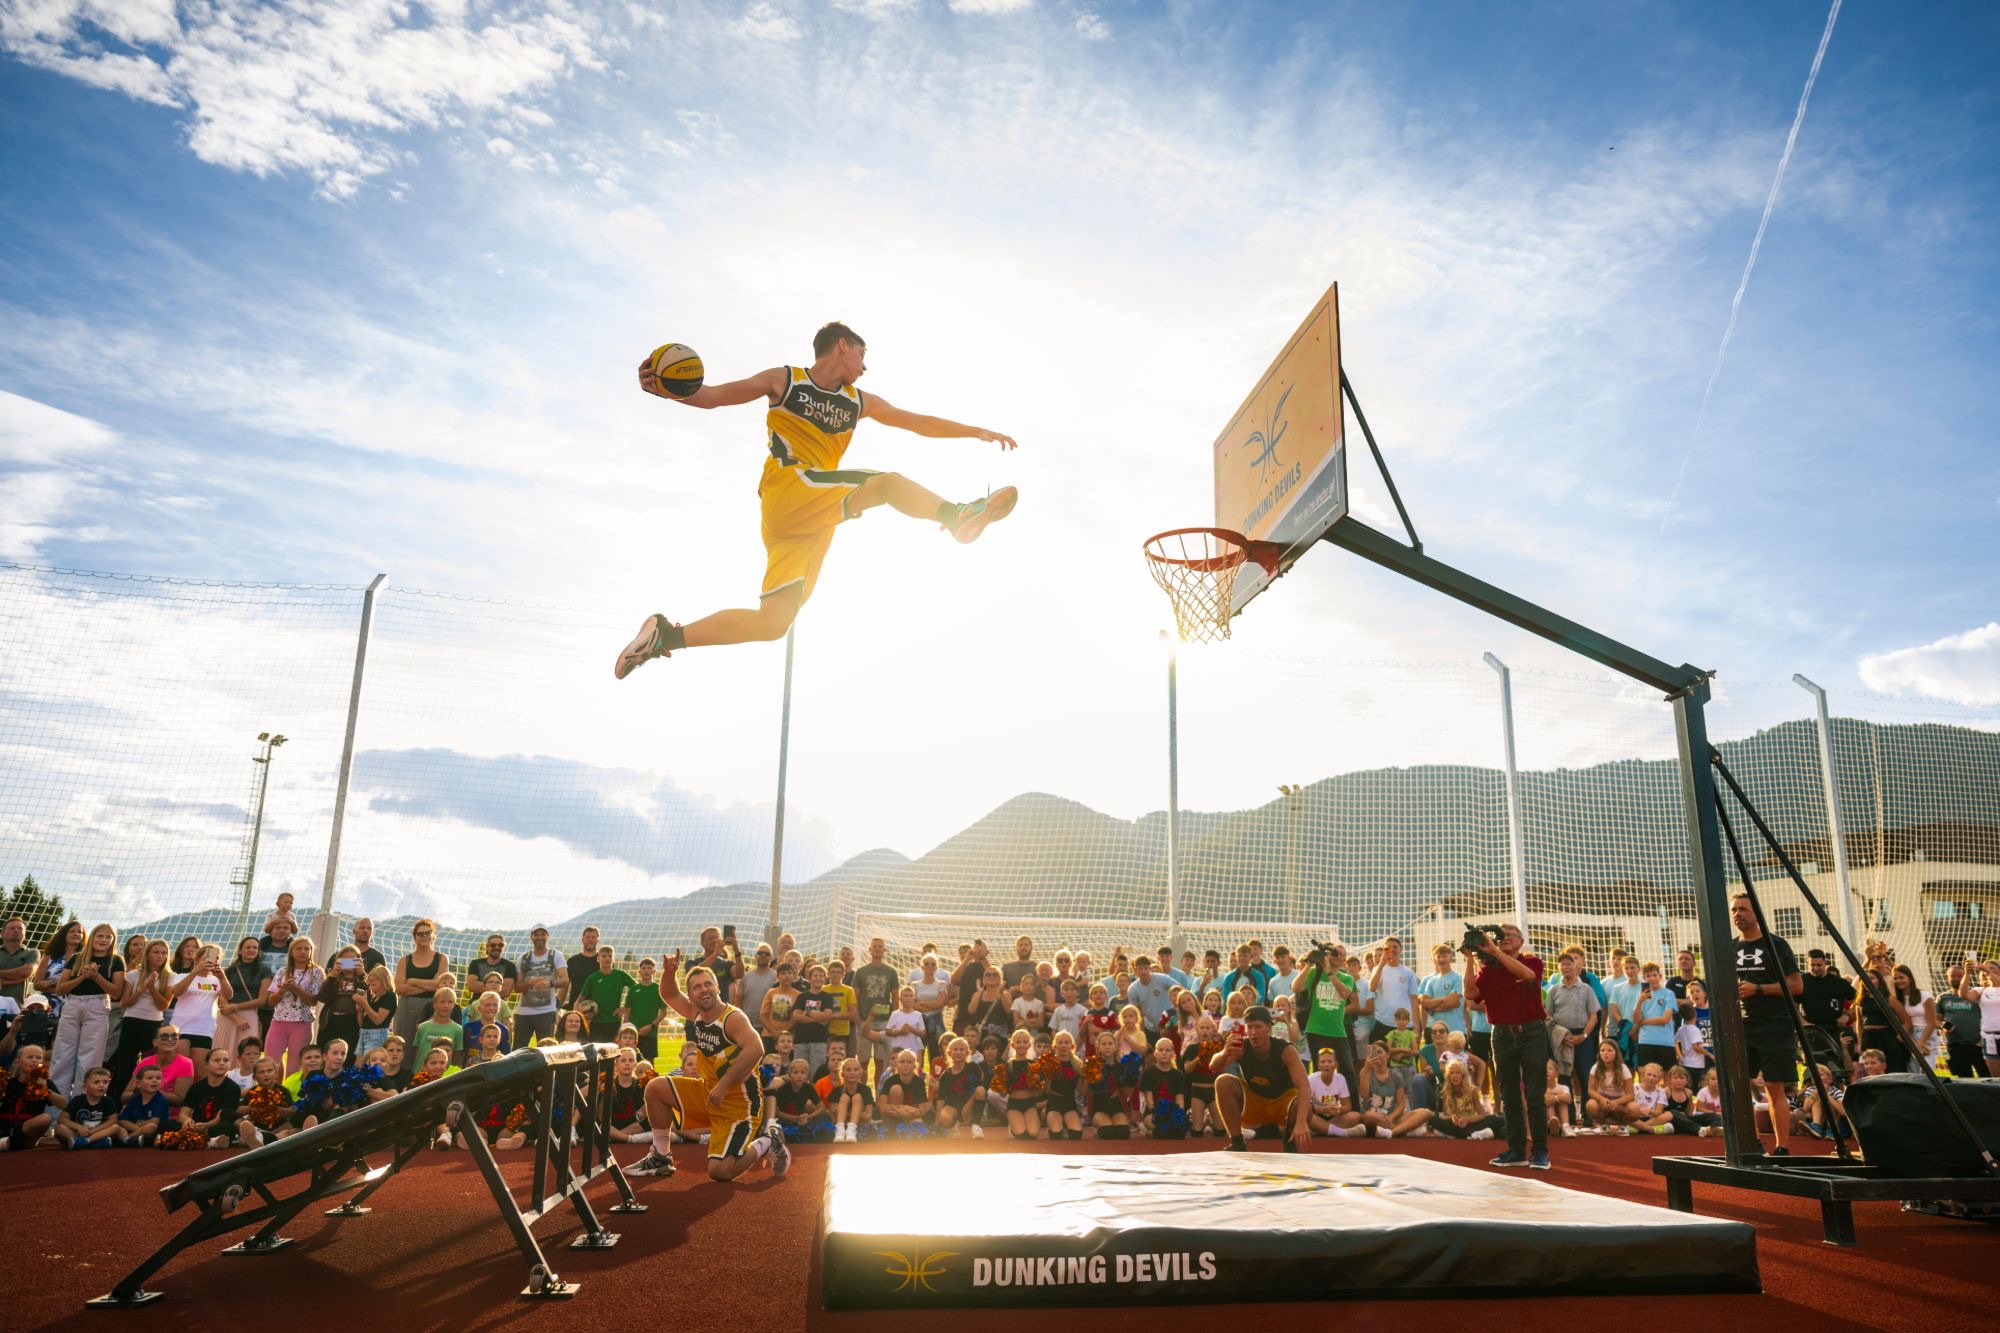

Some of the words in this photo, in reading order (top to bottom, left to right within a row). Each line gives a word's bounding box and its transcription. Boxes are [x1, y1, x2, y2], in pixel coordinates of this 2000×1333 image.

[803, 403, 842, 429] Devils
[1244, 491, 1273, 535] DUNKING
[1275, 462, 1301, 503] DEVILS
[973, 1255, 1106, 1286] DUNKING
[1116, 1252, 1217, 1283] DEVILS
